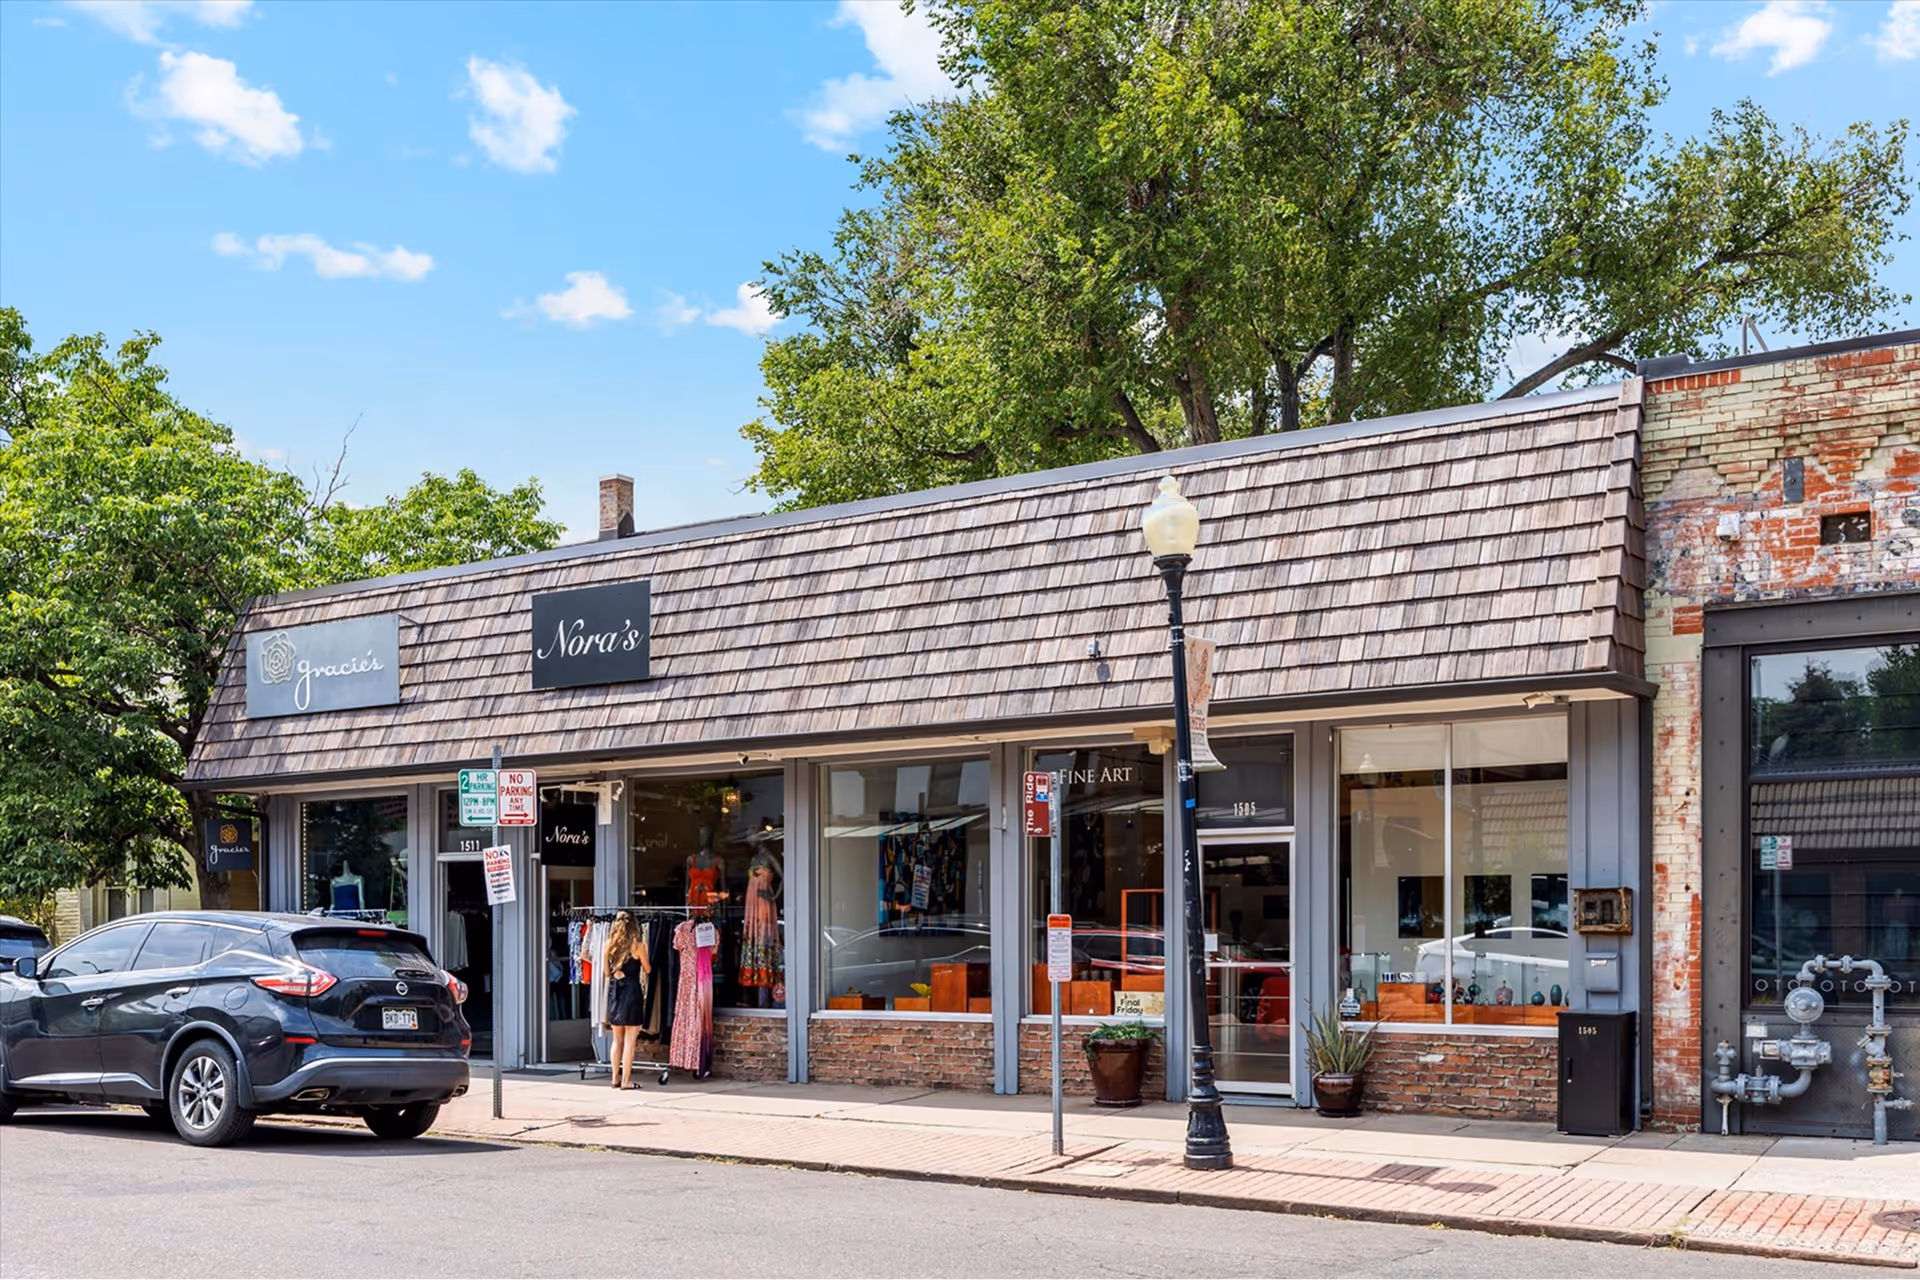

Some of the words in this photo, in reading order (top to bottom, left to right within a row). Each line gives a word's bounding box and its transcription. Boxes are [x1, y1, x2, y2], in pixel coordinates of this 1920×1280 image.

[536, 618, 645, 660] Nora's
[509, 774, 524, 784] NO
[1059, 768, 1096, 784] FINE
[1100, 766, 1133, 783] ART
[461, 774, 469, 790] 2
[476, 773, 488, 782] HR
[470, 782, 496, 790] PARKING
[501, 786, 533, 796] PARKING
[1233, 801, 1256, 816] 1505
[545, 825, 590, 845] Nora's
[460, 840, 480, 851] 1511
[485, 850, 499, 859] NO
[486, 858, 510, 866] PARKING
[1120, 998, 1140, 1007] Final
[1116, 1006, 1144, 1016] Friday
[1578, 1026, 1598, 1035] 1505
